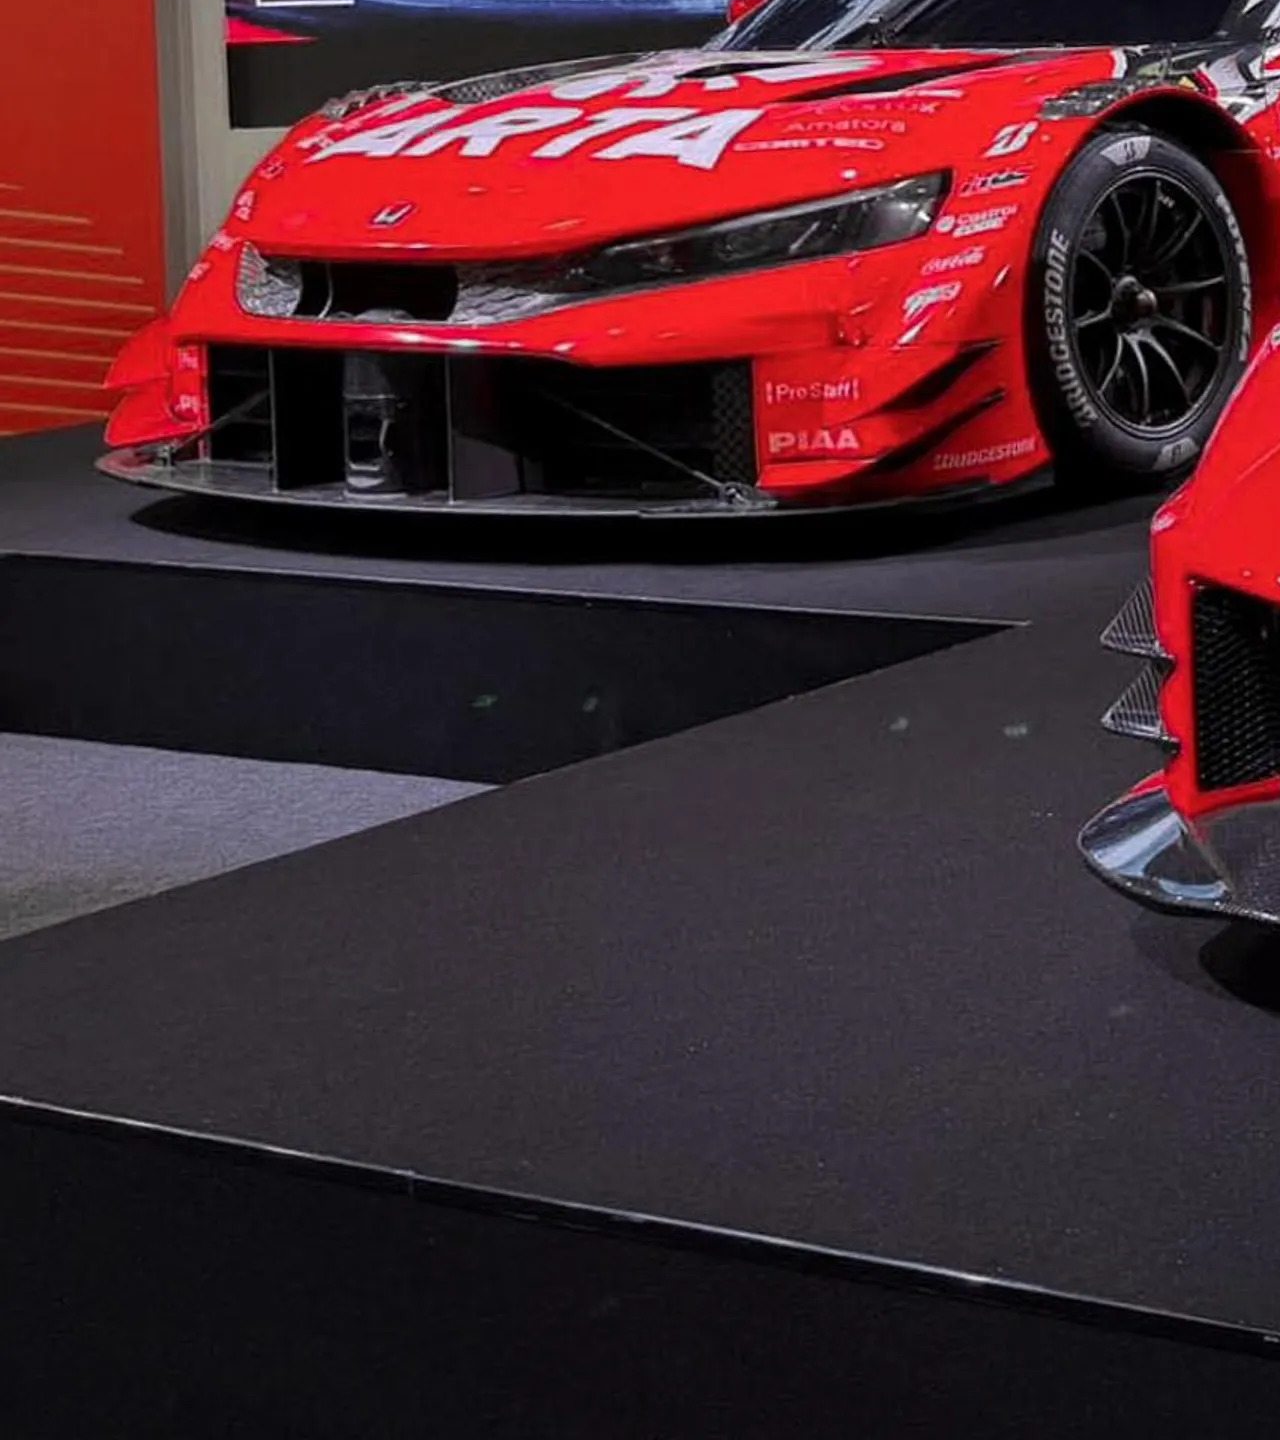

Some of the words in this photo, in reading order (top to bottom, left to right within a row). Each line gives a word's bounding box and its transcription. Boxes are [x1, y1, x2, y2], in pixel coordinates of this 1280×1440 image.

[303, 108, 764, 170] ARTA
[1044, 228, 1100, 428] BRIDGESTONE
[768, 428, 861, 454] PIAA
